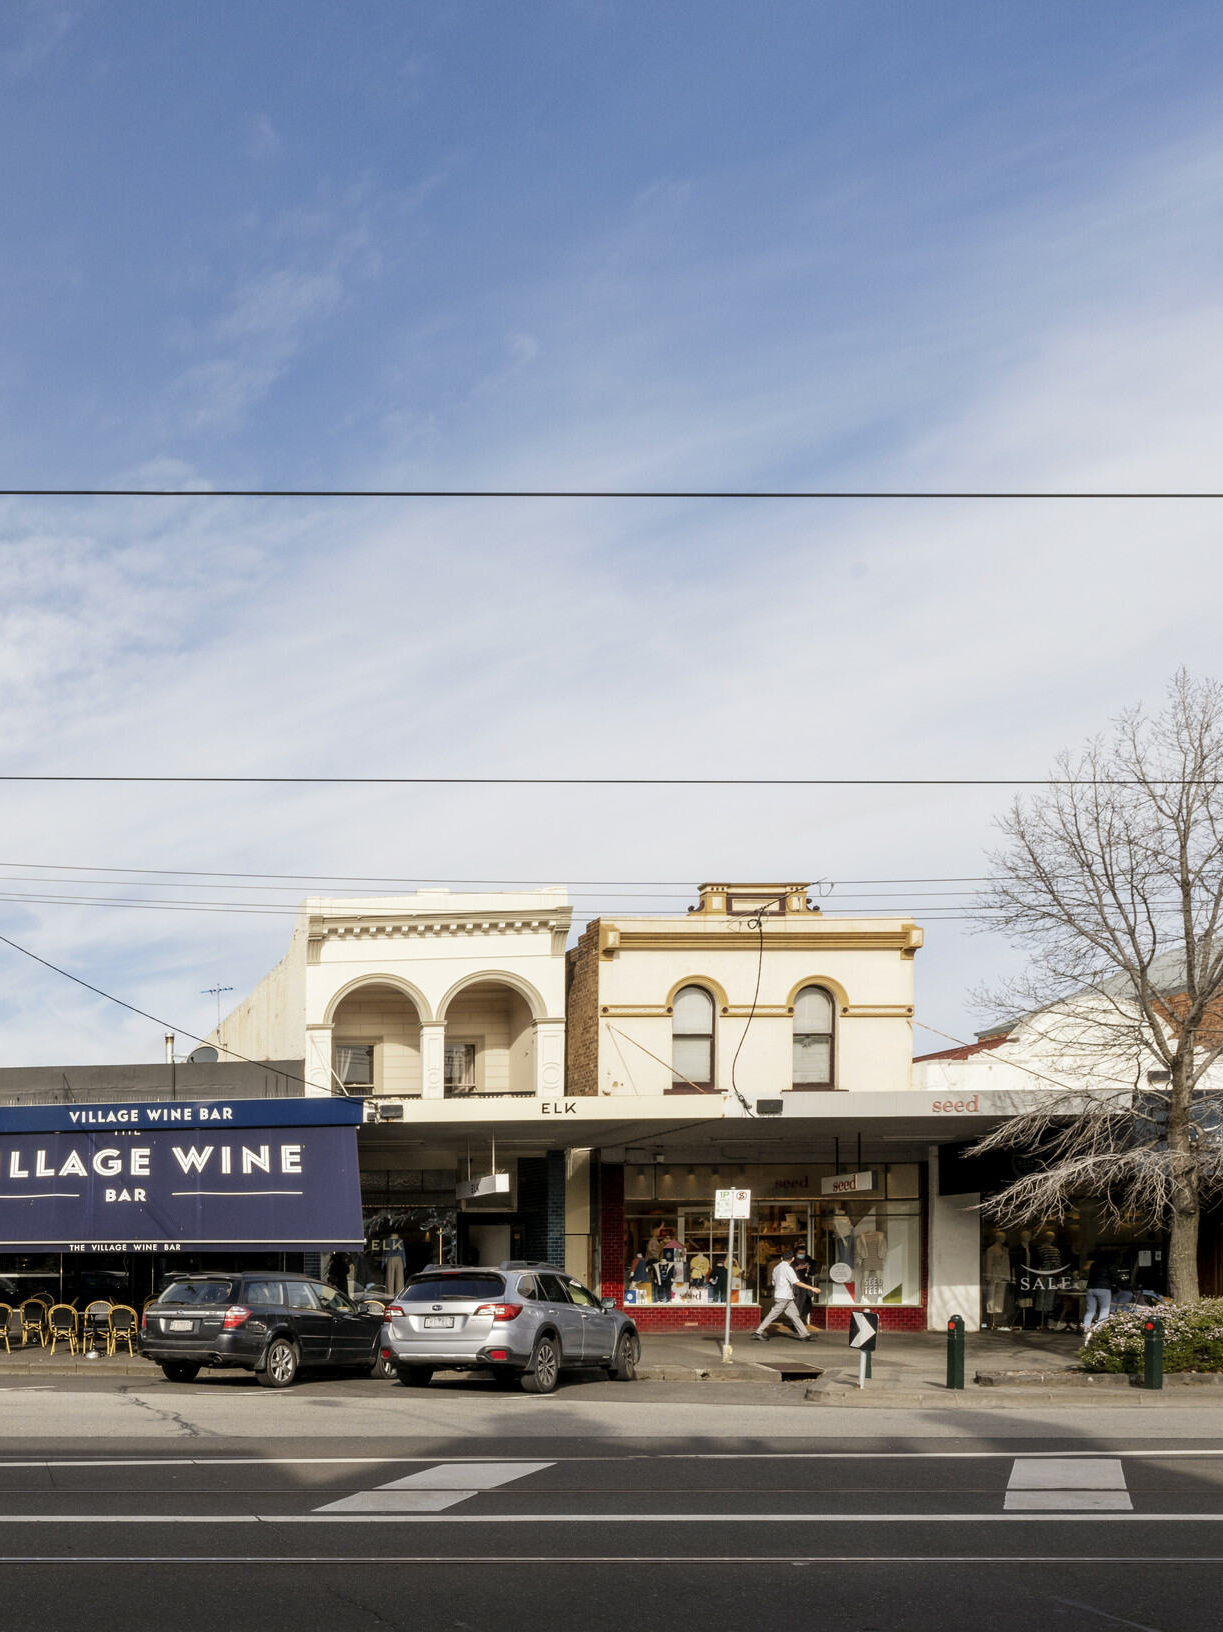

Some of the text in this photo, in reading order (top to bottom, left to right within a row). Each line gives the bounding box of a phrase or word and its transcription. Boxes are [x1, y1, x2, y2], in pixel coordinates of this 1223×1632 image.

[541, 1102, 577, 1114] ELK
[932, 1094, 979, 1113] seed
[69, 1107, 234, 1124] VILLAGE WINE BAR
[172, 1144, 302, 1174] WINE
[833, 1174, 857, 1192] seed
[105, 1188, 147, 1202] BAR
[69, 1243, 182, 1252] THE VILLAGE WINE BAR
[371, 1239, 403, 1250] ELK
[1020, 1277, 1072, 1291] SALE
